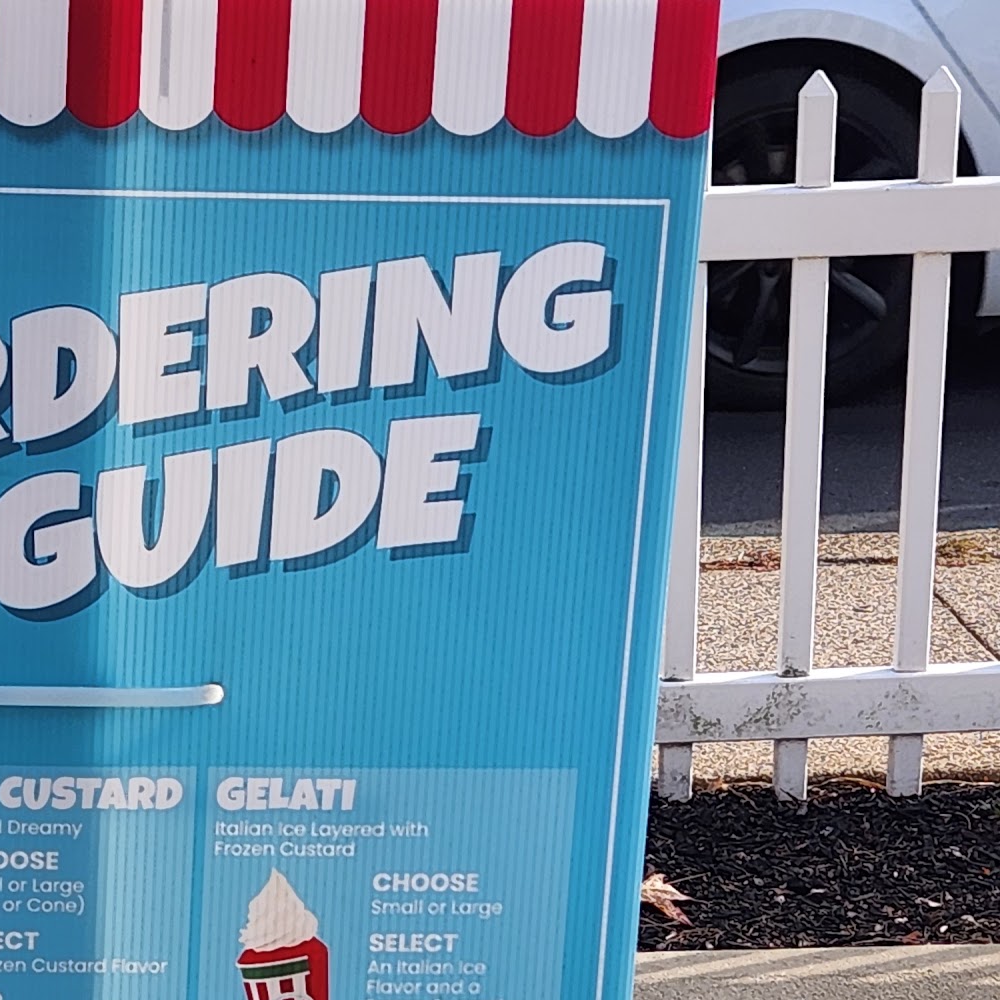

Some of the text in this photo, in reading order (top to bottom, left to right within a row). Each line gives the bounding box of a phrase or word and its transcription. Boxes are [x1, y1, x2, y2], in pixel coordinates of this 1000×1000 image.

[217, 777, 356, 810] GELATI
[8, 820, 82, 838] Dreamy
[215, 822, 428, 841] Italian Ice Layered with
[215, 842, 355, 857] Frozen Custard
[373, 873, 479, 892] CHOOSE
[3, 899, 22, 912] or
[28, 896, 85, 916] Cone)
[369, 934, 458, 952] SELECT
[32, 958, 106, 973] Custard
[112, 959, 168, 973] Flavor
